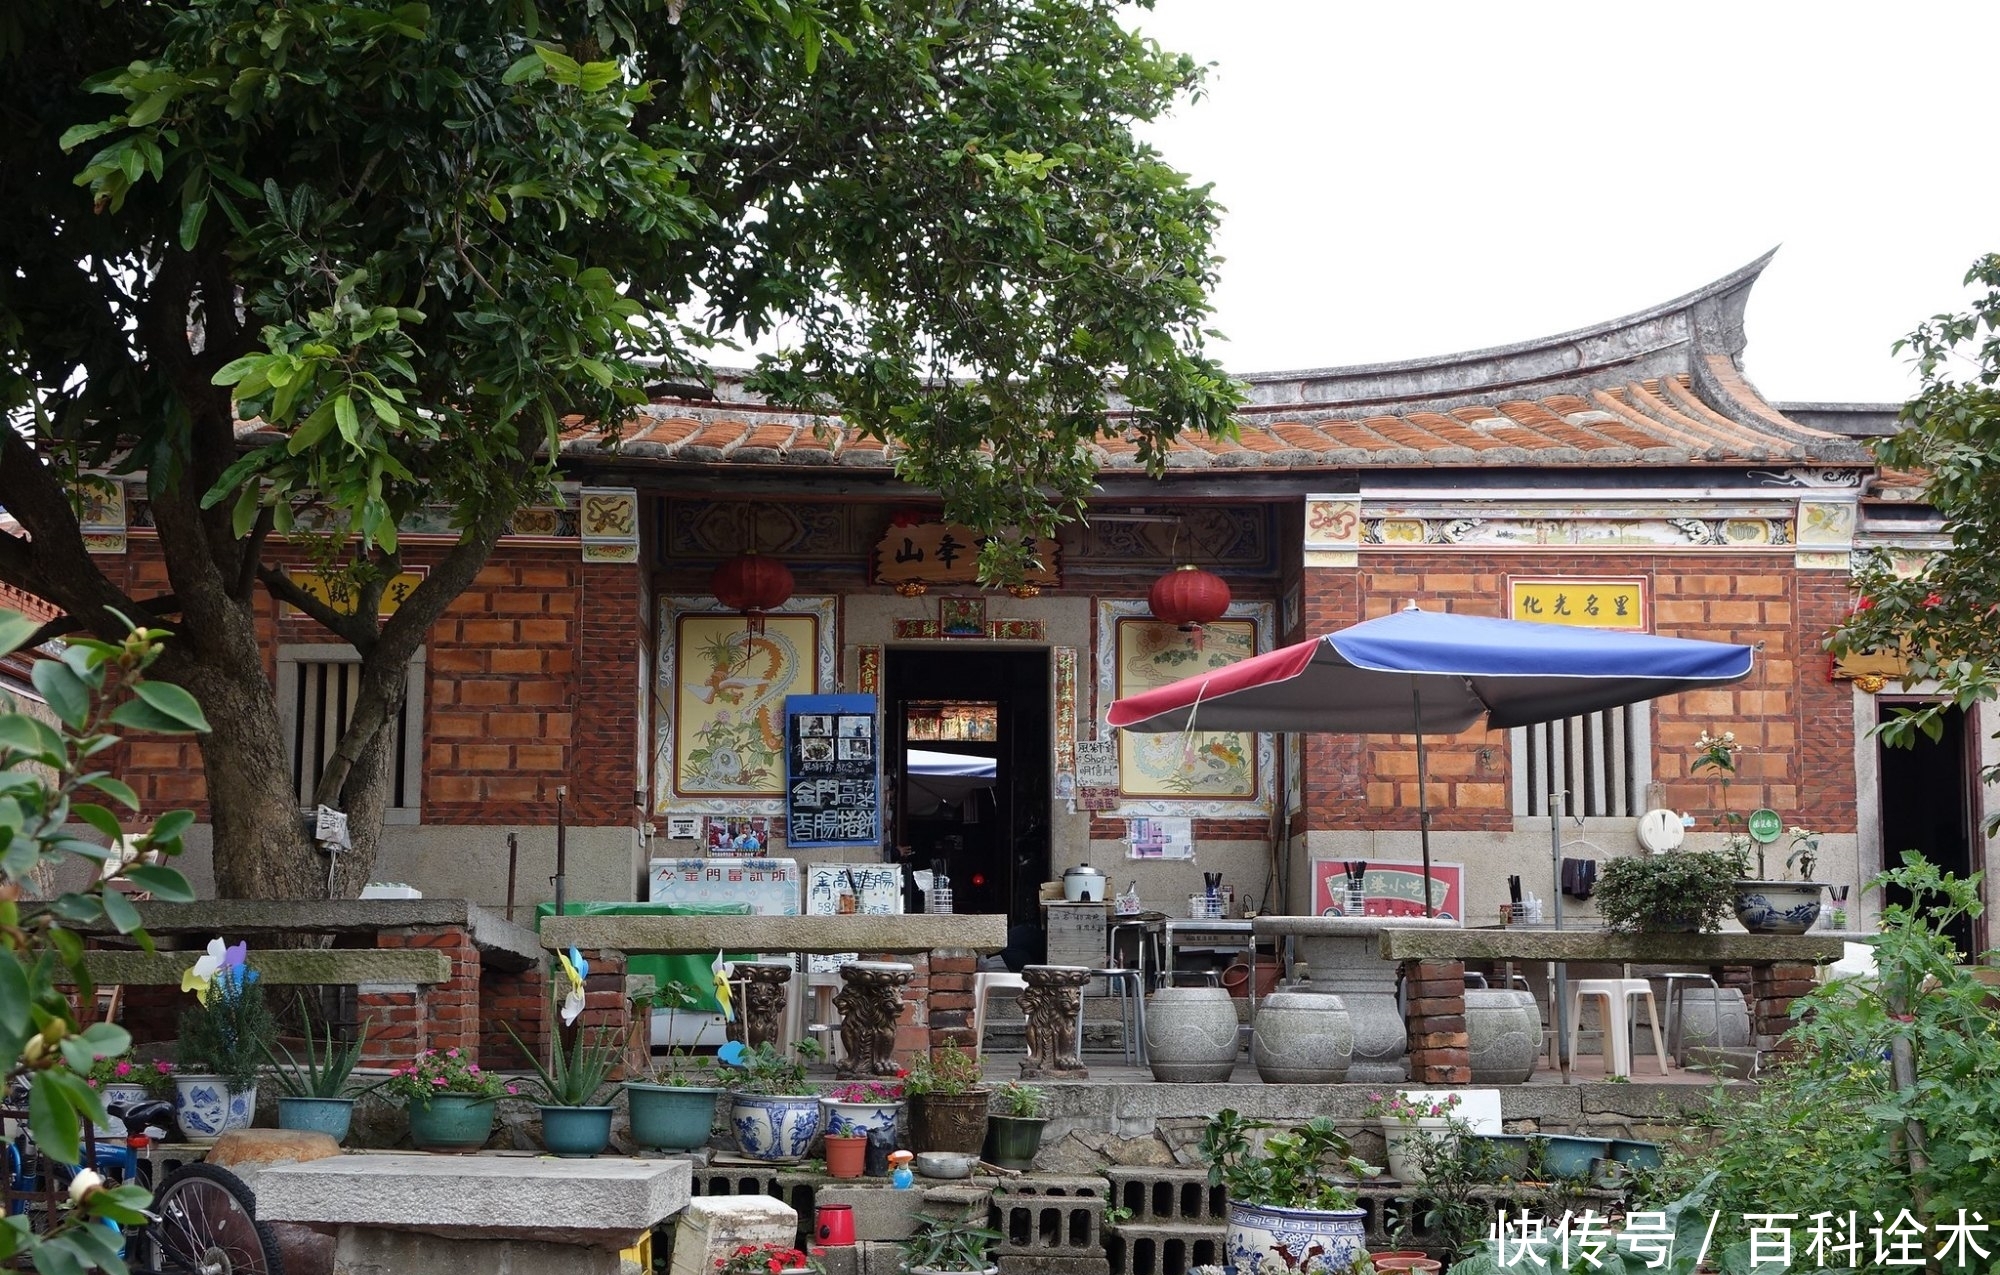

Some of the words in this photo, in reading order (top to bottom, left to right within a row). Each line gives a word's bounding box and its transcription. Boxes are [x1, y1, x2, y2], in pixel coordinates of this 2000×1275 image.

[1084, 753, 1107, 763] Shop
[792, 809, 876, 841] 香腸捲餅
